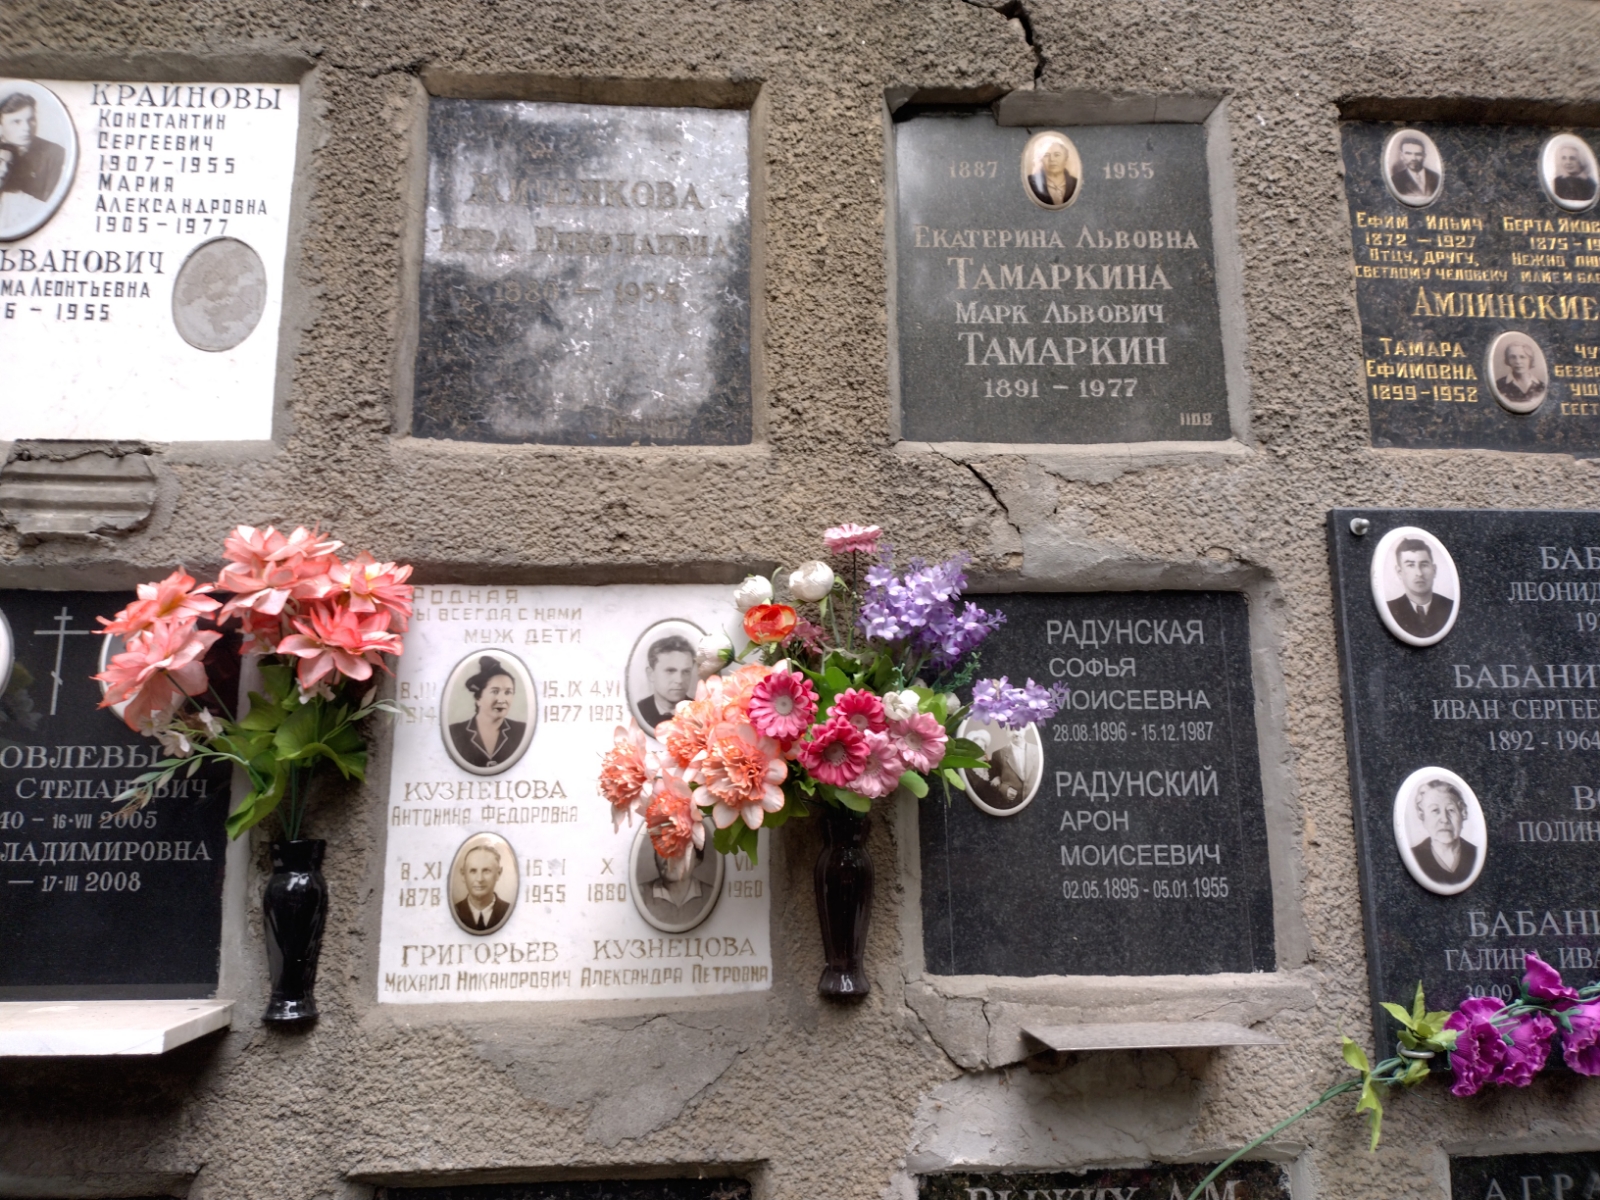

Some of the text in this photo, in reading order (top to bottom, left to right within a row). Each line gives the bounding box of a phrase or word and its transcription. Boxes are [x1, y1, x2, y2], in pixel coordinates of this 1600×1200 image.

[99, 108, 226, 130] КОНСТАНТИН
[97, 131, 213, 151] СЕРГЕЕВИЧ
[950, 161, 1154, 179] 1887 1955
[98, 173, 174, 193] МАРИЯ
[95, 194, 268, 216] АЛЕКСАНДРОВНА
[1356, 211, 1483, 231] ЕФИМ ИЛЬИЧ
[1503, 216, 1555, 232] БЕРТА
[915, 225, 1200, 249] ЕКАТЕРИНА ЛЬВОВНА
[1365, 232, 1408, 246] 1872
[1437, 234, 1476, 248] 1927
[1530, 236, 1569, 250] 1875
[1369, 248, 1480, 267] ОТЦУ, ДРУГУ,
[1511, 252, 1566, 267] НЕЖНО
[947, 257, 1173, 290] ТАМАРКИНА
[1354, 265, 1508, 282] СВЕТЛОМУ ЧЕЛОВЕКУ
[1520, 270, 1560, 283] МАМЕ
[1563, 271, 1573, 283] И
[31, 276, 151, 298] ЛЕОНТЬЕВНА
[56, 304, 110, 321] 1955
[955, 301, 1164, 324] МАРК ЛЬВОВИЧ
[1411, 286, 1600, 320] АМЛИНСКИЕ
[958, 331, 1168, 366] ТАМАРКИН
[1379, 337, 1467, 357] ТАМАРА
[1366, 359, 1478, 380] ЕФИМОВНА
[984, 378, 1040, 398] 1891
[1079, 378, 1138, 398] 1977
[1560, 402, 1600, 415] СЕСТ
[411, 607, 582, 622] Ы ВСЕГДА С НАМИ
[464, 628, 582, 645] МУЖ ДЕТИ
[1046, 619, 1204, 649] РАДУНСКАЯ
[1050, 657, 1136, 677] СОФЬЯ
[544, 704, 582, 723] 1977
[589, 704, 623, 722] 1903
[1433, 699, 1600, 720] ИВАН СЕРГЕЕ
[1053, 721, 1127, 742] 28.08.1896
[1141, 721, 1213, 742] 15.12.1987
[1488, 730, 1535, 750] 1892
[1556, 730, 1600, 750] 1964
[15, 777, 208, 799] СТЕПАНВИЧ
[404, 780, 567, 801] КУЗНЕЦОВА
[1055, 765, 1219, 802] РАДУНСКИЙ
[100, 811, 157, 829] 2005
[391, 805, 578, 827] АНТОНИНА ФЕДОРОВНА
[1060, 810, 1129, 831] АРОН
[0, 841, 212, 866] ЛАДИМИРОВНА
[1060, 844, 1221, 866] МОИСЕЕВИЧ
[85, 871, 141, 892] 2008
[587, 880, 763, 902] 1880 1960
[1062, 877, 1139, 899] 02.05.1895
[1153, 877, 1228, 899] 05.01.1955
[400, 884, 566, 908] 1878 1955
[400, 941, 559, 967] ГРИГОРЬЕВ
[593, 937, 757, 961] КУЗНЕЦОВА
[1444, 947, 1543, 971] ГАЛИН
[385, 970, 571, 993] МИХАИЛ НИКАНОРОВИЧ
[580, 964, 769, 987] АЛЕКСАНДРА ПЕТРОВНА
